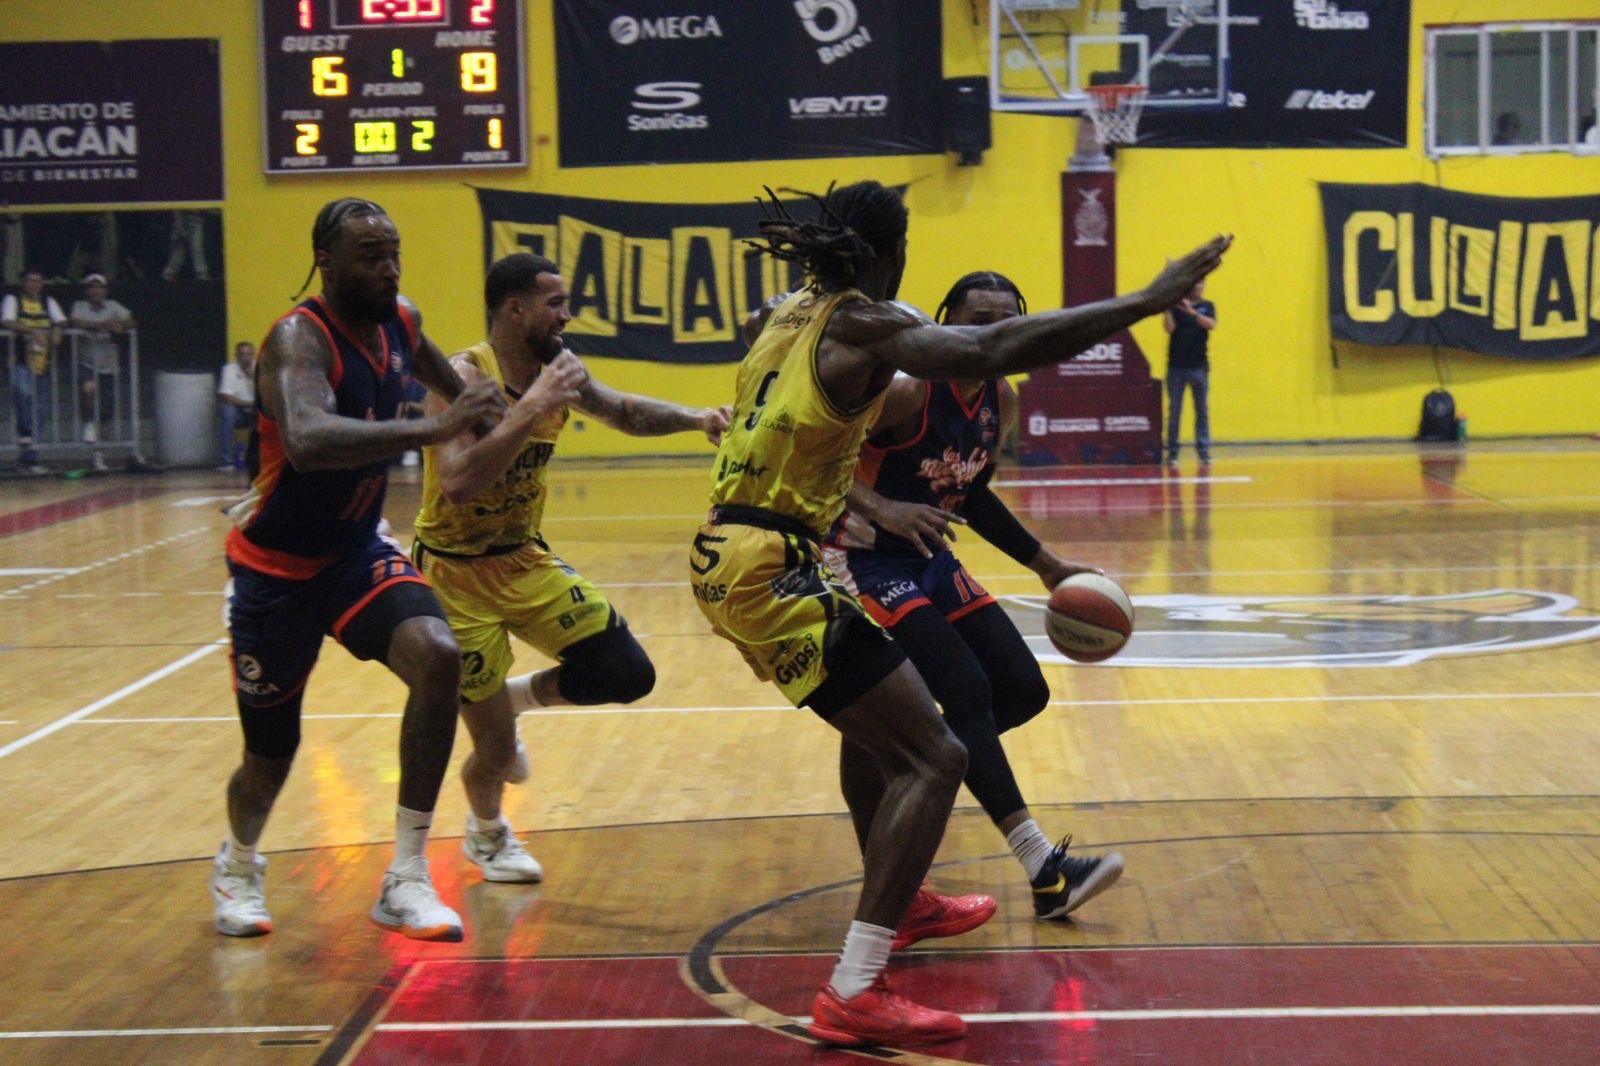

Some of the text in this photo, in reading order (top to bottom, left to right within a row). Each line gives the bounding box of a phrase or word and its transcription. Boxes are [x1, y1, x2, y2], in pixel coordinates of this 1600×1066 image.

[281, 35, 348, 52] GUEST
[434, 30, 497, 48] HOME
[817, 26, 872, 64] Berel
[391, 48, 404, 77] 1
[102, 102, 134, 119] DE
[788, 95, 888, 114] VENTO
[411, 120, 435, 151] 2
[487, 118, 502, 149] 1
[627, 113, 709, 132] SoniGas
[0, 121, 138, 158] IACÁN
[296, 123, 320, 155] 2
[33, 168, 138, 181] BIENESTAR
[1343, 211, 1600, 340] CULIA
[690, 532, 728, 575] 5
[880, 581, 919, 606] MEGA
